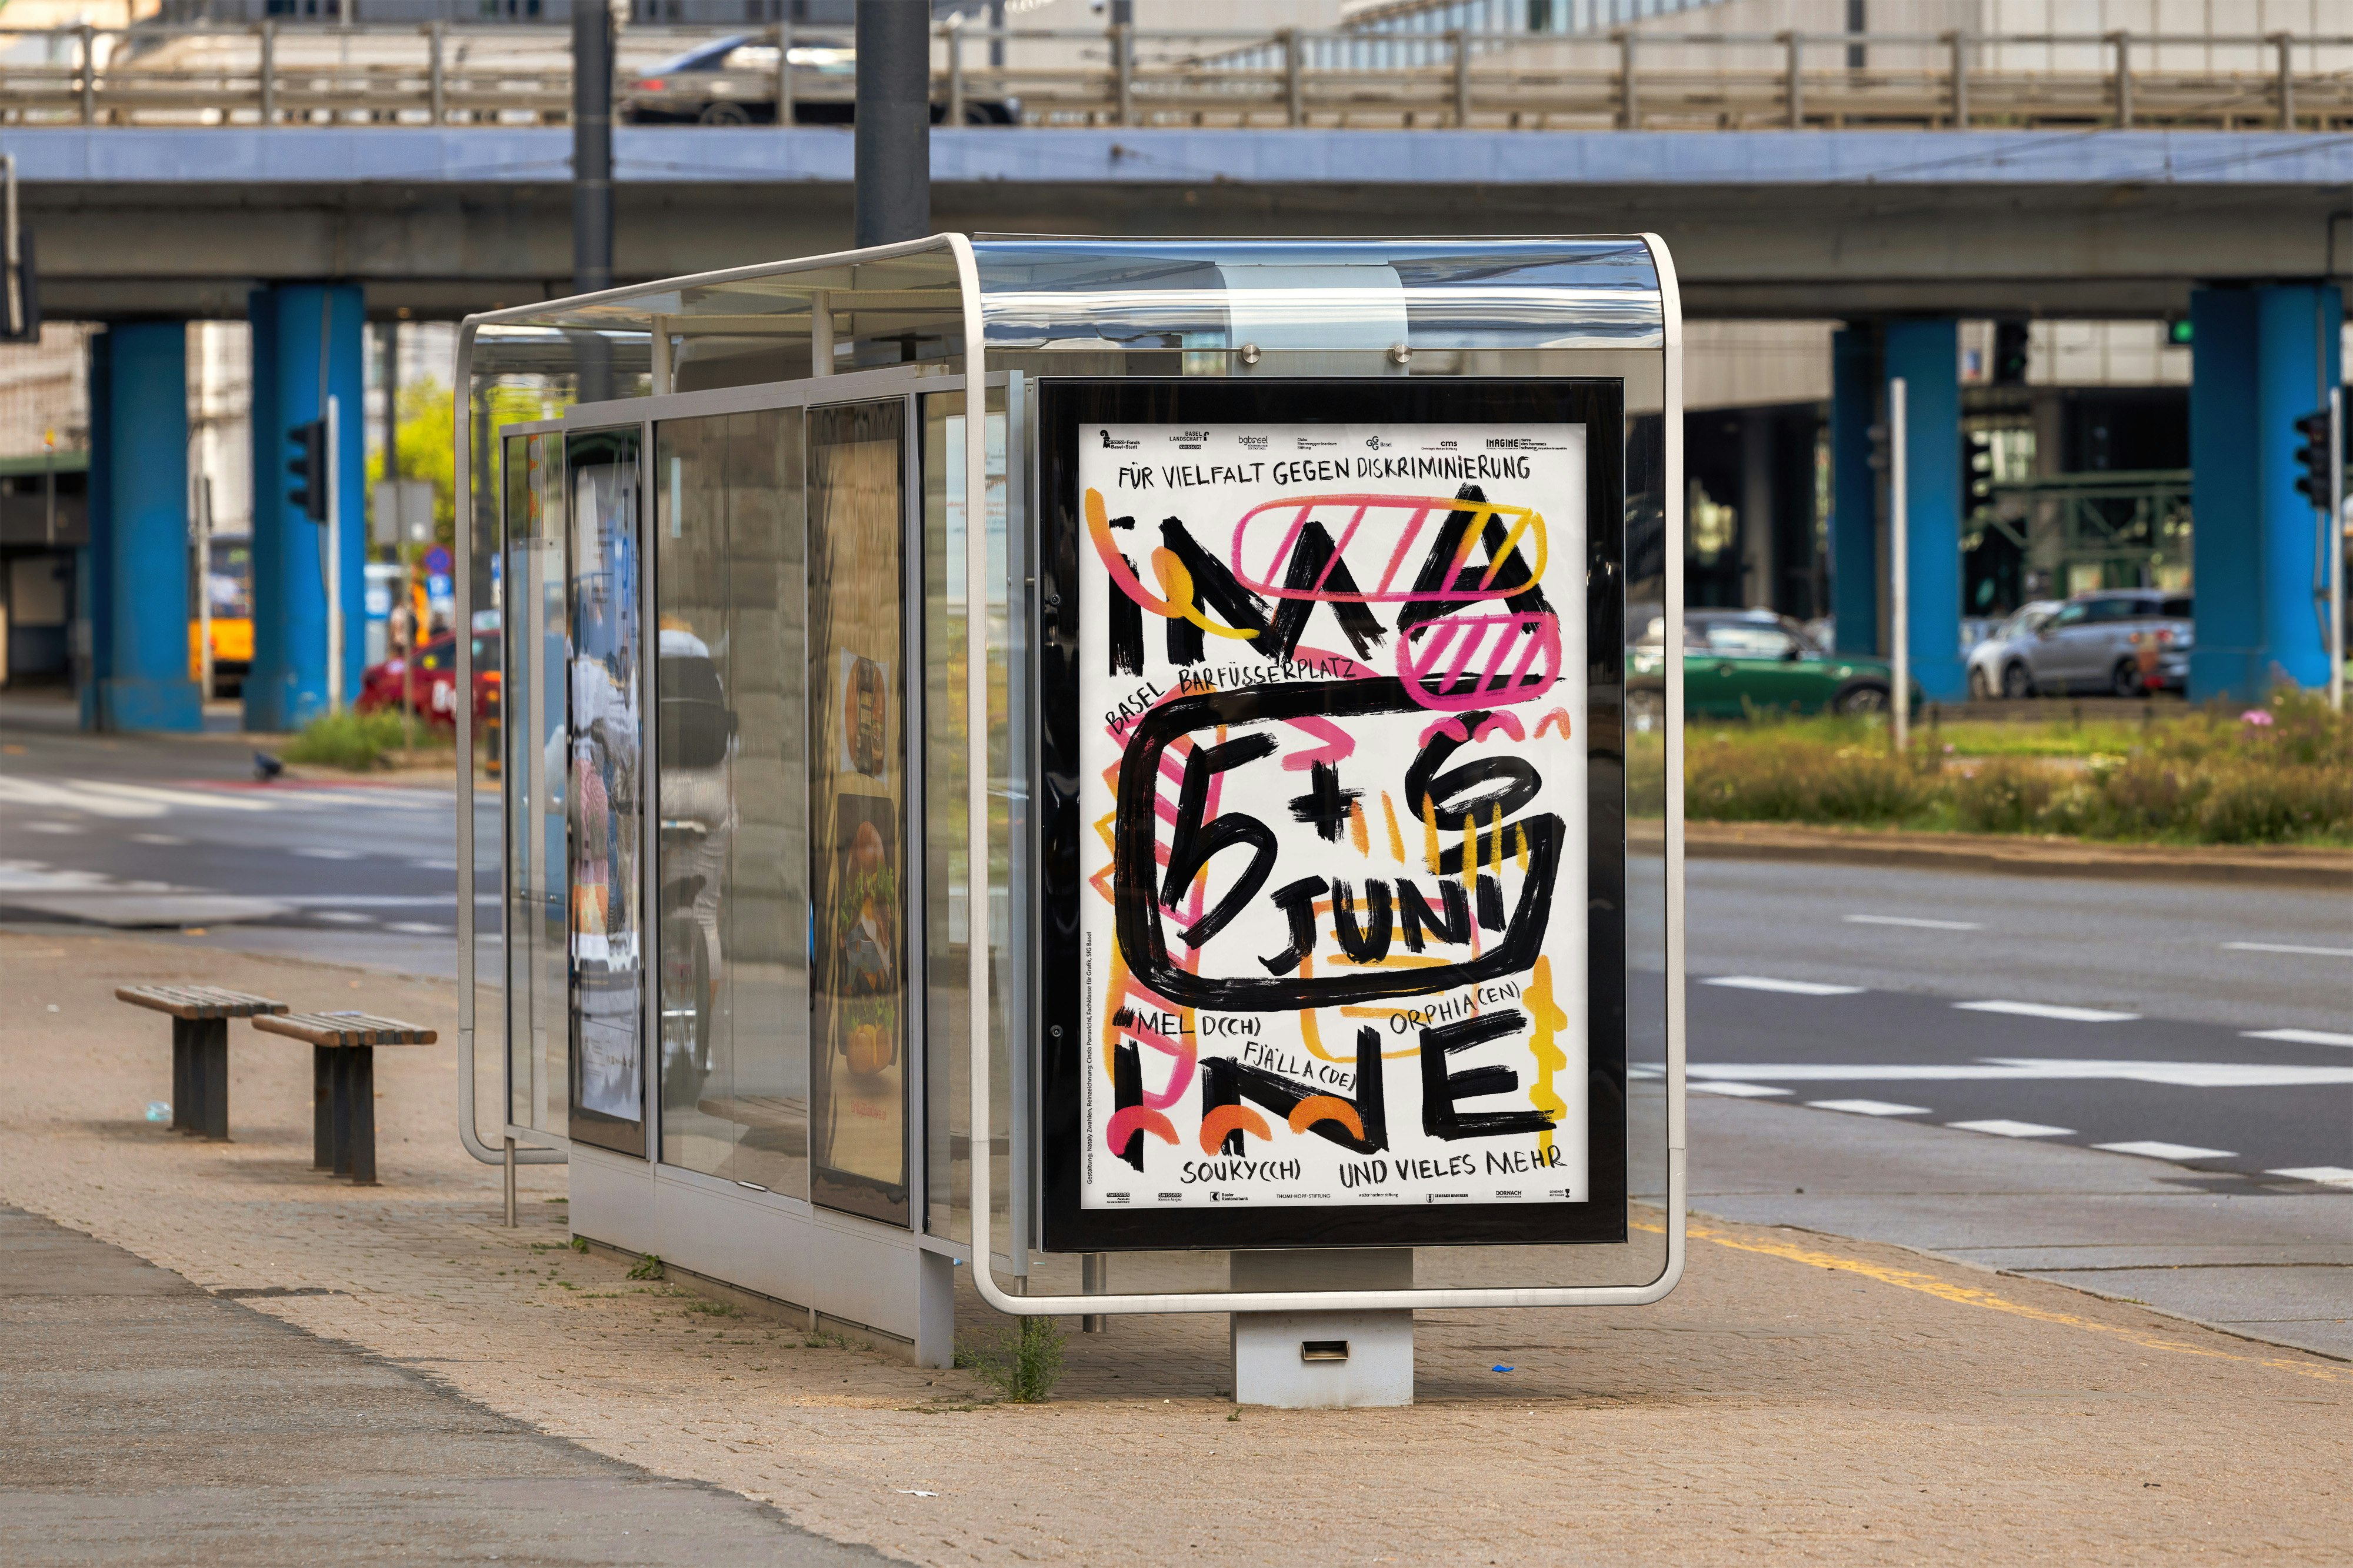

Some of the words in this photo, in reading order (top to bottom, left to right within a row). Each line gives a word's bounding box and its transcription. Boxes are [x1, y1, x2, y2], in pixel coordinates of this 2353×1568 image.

[1486, 439, 1519, 448] IMAGINE
[1119, 461, 1154, 490] FÜR
[1162, 462, 1265, 489] VIELFALT
[1273, 457, 1349, 486] GEGEN
[1105, 680, 1165, 735] BASEL
[1178, 656, 1357, 695] BARFÜSSERPLATZ
[1258, 874, 1507, 976] JUNI
[1137, 1009, 1195, 1036] MEL
[1244, 1040, 1315, 1079] FJÄLLA
[1339, 1160, 1388, 1189] UND
[1395, 1153, 1476, 1180] VIELES
[1487, 1145, 1568, 1175] MEHR
